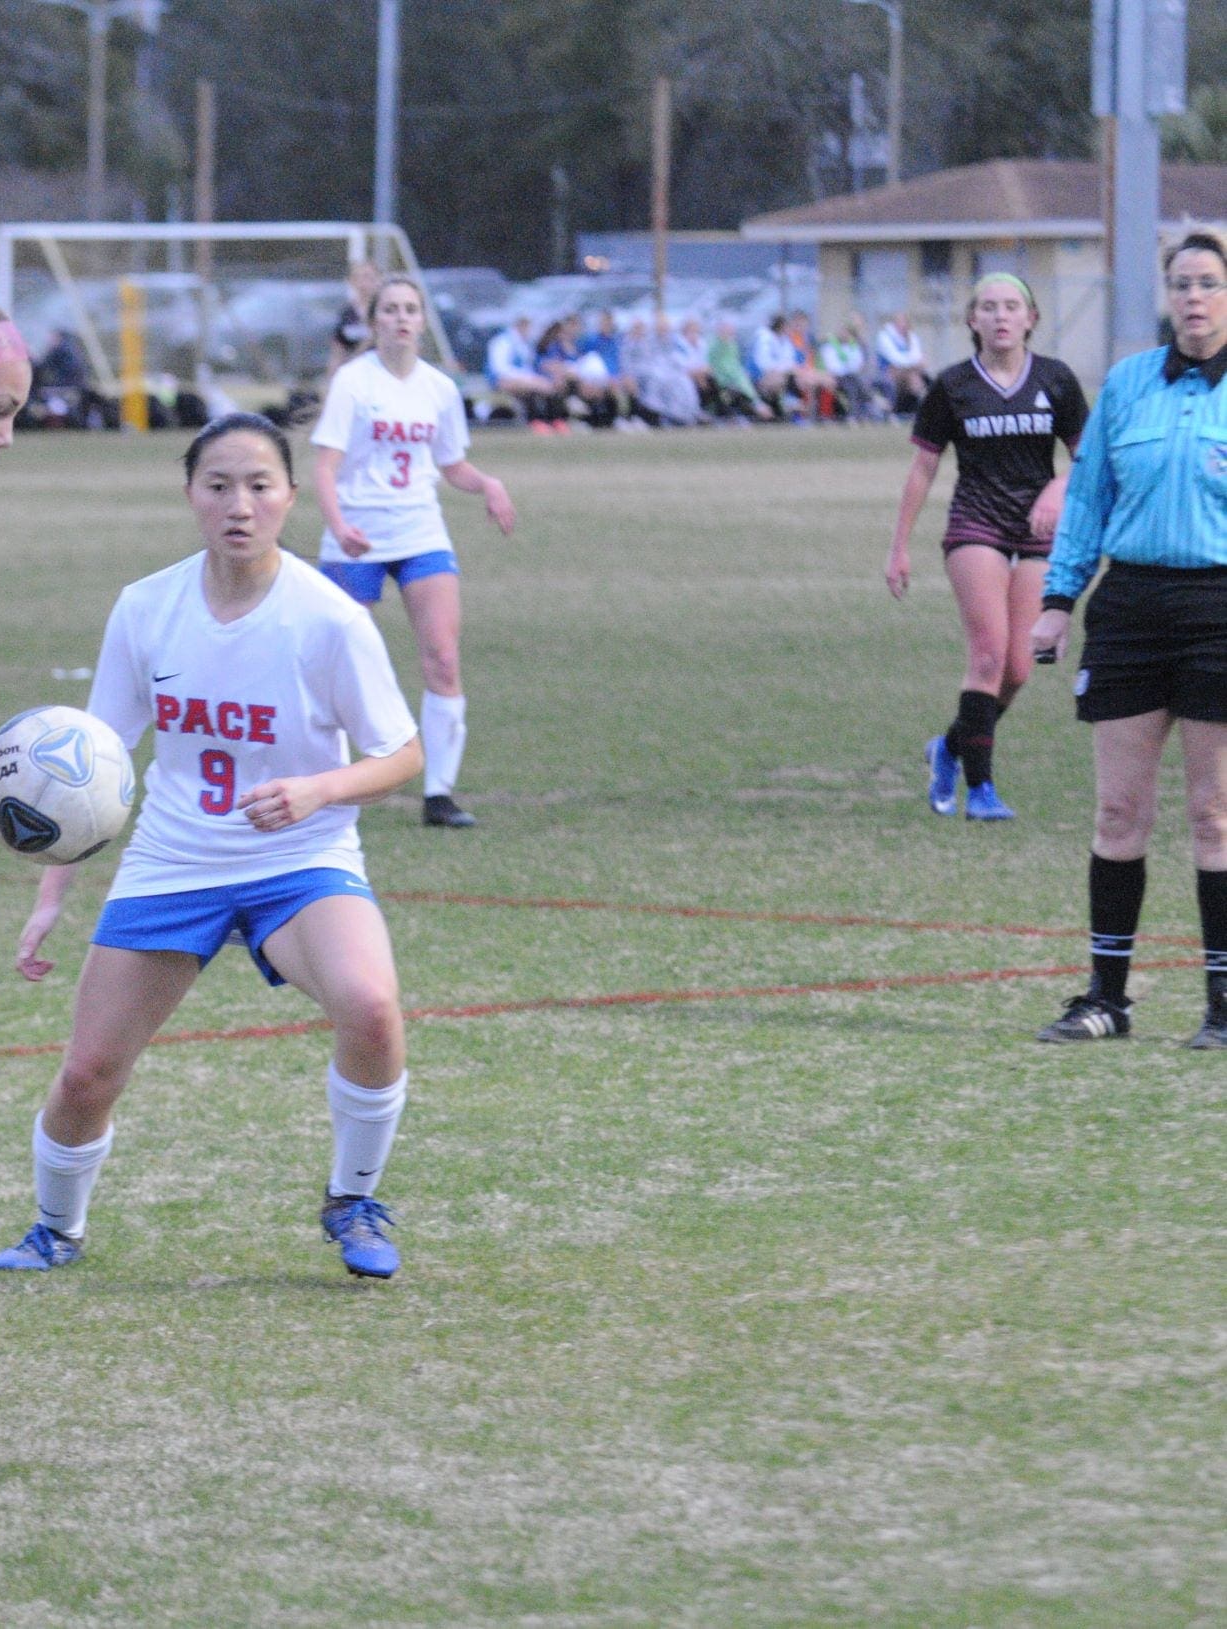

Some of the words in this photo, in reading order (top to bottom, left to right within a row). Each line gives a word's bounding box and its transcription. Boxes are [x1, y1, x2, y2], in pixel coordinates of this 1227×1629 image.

[964, 413, 1054, 438] NAVARRE
[390, 451, 411, 489] 3
[155, 693, 277, 745] PACE
[199, 748, 236, 816] 9
